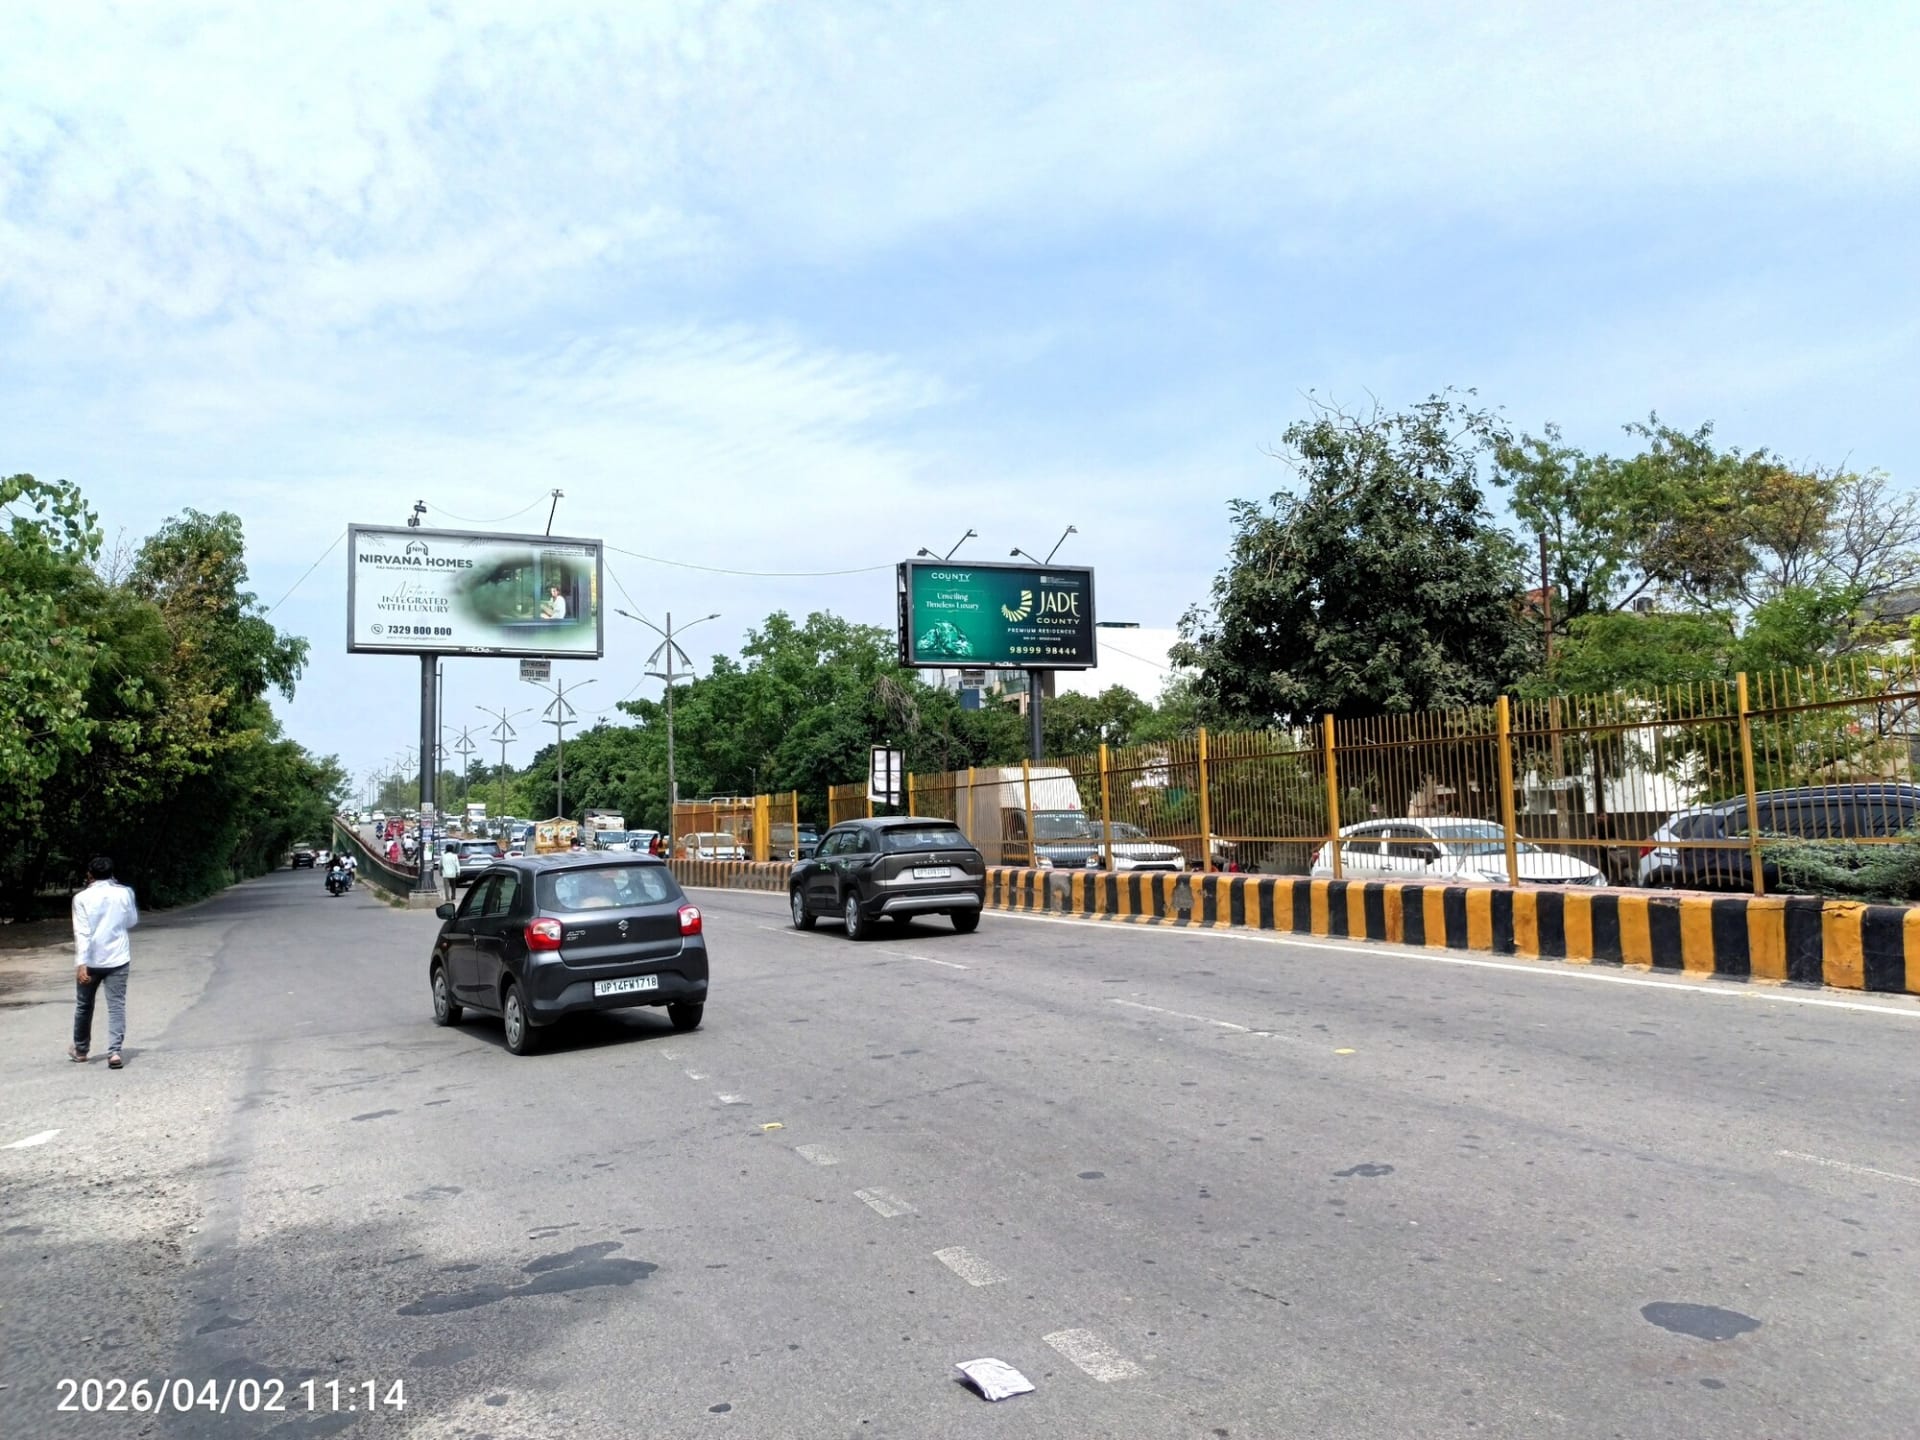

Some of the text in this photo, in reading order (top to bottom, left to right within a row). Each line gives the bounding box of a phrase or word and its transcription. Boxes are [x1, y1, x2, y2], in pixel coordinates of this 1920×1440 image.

[359, 553, 473, 569] NIRVANA HOMES
[931, 572, 971, 581] COUNTY
[382, 595, 449, 606] INTEGRATED
[937, 592, 968, 602] Unveiling
[377, 603, 450, 614] WITH LUXURY
[926, 601, 979, 611] Timeless Luxury
[1036, 591, 1080, 618] JADE
[1036, 617, 1080, 625] COUNTY
[388, 625, 452, 636] 7329 800 800
[1009, 646, 1077, 655] 98999 98444
[600, 976, 657, 994] UP14FW1718
